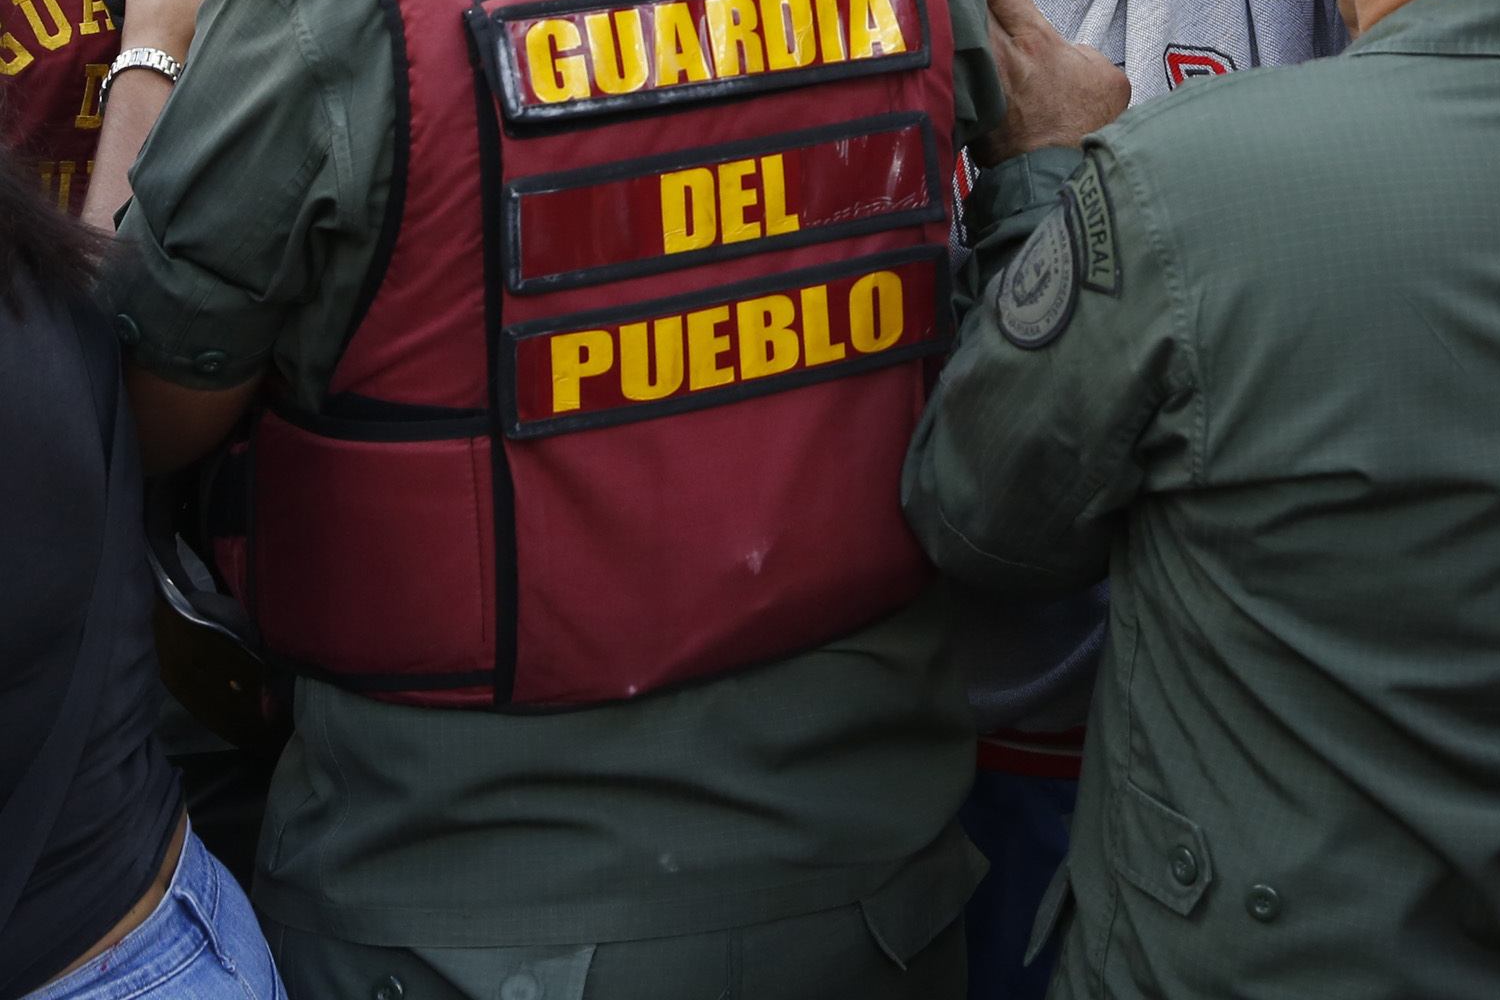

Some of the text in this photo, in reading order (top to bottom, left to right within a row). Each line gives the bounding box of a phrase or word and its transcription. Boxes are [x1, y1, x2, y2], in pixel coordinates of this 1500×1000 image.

[660, 153, 800, 255] DEL
[1080, 174, 1111, 278] CENTRAL
[551, 271, 903, 412] PUEBLO
